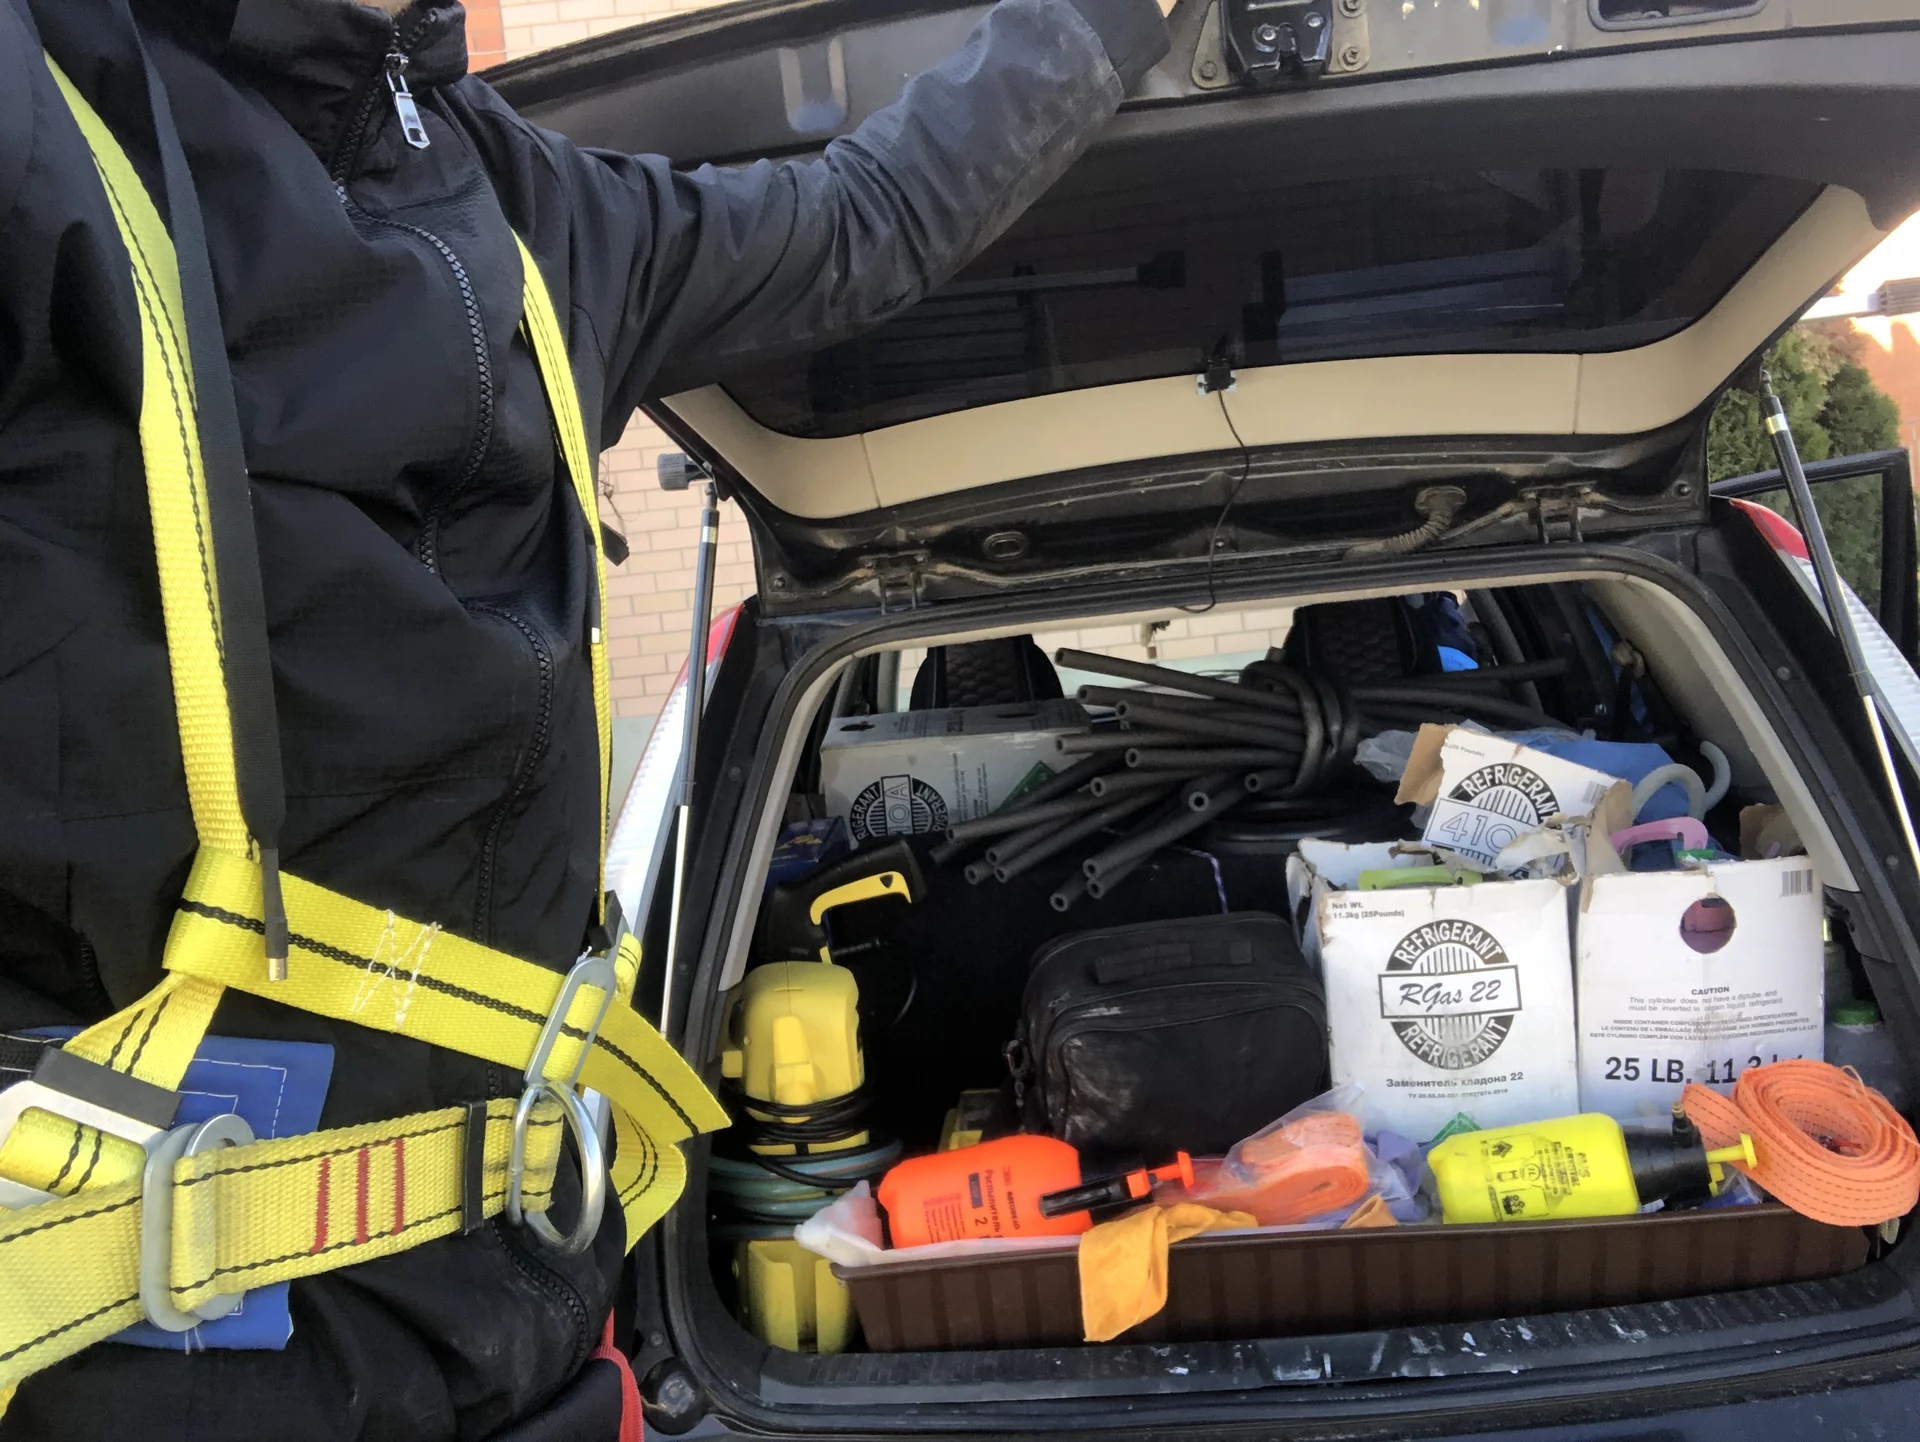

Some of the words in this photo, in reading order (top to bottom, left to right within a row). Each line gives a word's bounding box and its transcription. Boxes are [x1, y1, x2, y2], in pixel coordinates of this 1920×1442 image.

[852, 785, 881, 840] RIGERANT
[1440, 811, 1517, 853] 410
[1332, 902, 1347, 910] Net
[1349, 901, 1364, 909] Wt.
[1333, 911, 1359, 920] 11.3kg
[1361, 909, 1405, 919] (25Pounds)
[1394, 921, 1504, 964] REFRIGERANT
[1399, 981, 1463, 1012] RGas
[1469, 979, 1502, 1001] 22
[1629, 996, 1645, 1005] This
[1648, 996, 1676, 1006] cylinder
[1680, 996, 1698, 1005] does
[1702, 996, 1713, 1004] not
[1713, 994, 1730, 1003] have
[1764, 989, 1778, 998] and
[1691, 986, 1730, 996] CAUTION
[1628, 1004, 1647, 1012] must
[1648, 1004, 1658, 1012] be
[1662, 1004, 1691, 1012] inverted
[1693, 1004, 1700, 1012] to
[1748, 996, 1783, 1008] refrigerant
[1400, 1018, 1508, 1068] REFRIGERANT
[1385, 1077, 1457, 1088] Заменитель
[1460, 1073, 1507, 1087] хладона
[1510, 1071, 1524, 1081] 22
[1605, 1056, 1640, 1082] 25
[1651, 1058, 1692, 1085] LB.
[984, 1169, 1001, 1233] Распылитель
[975, 1216, 988, 1227] 2
